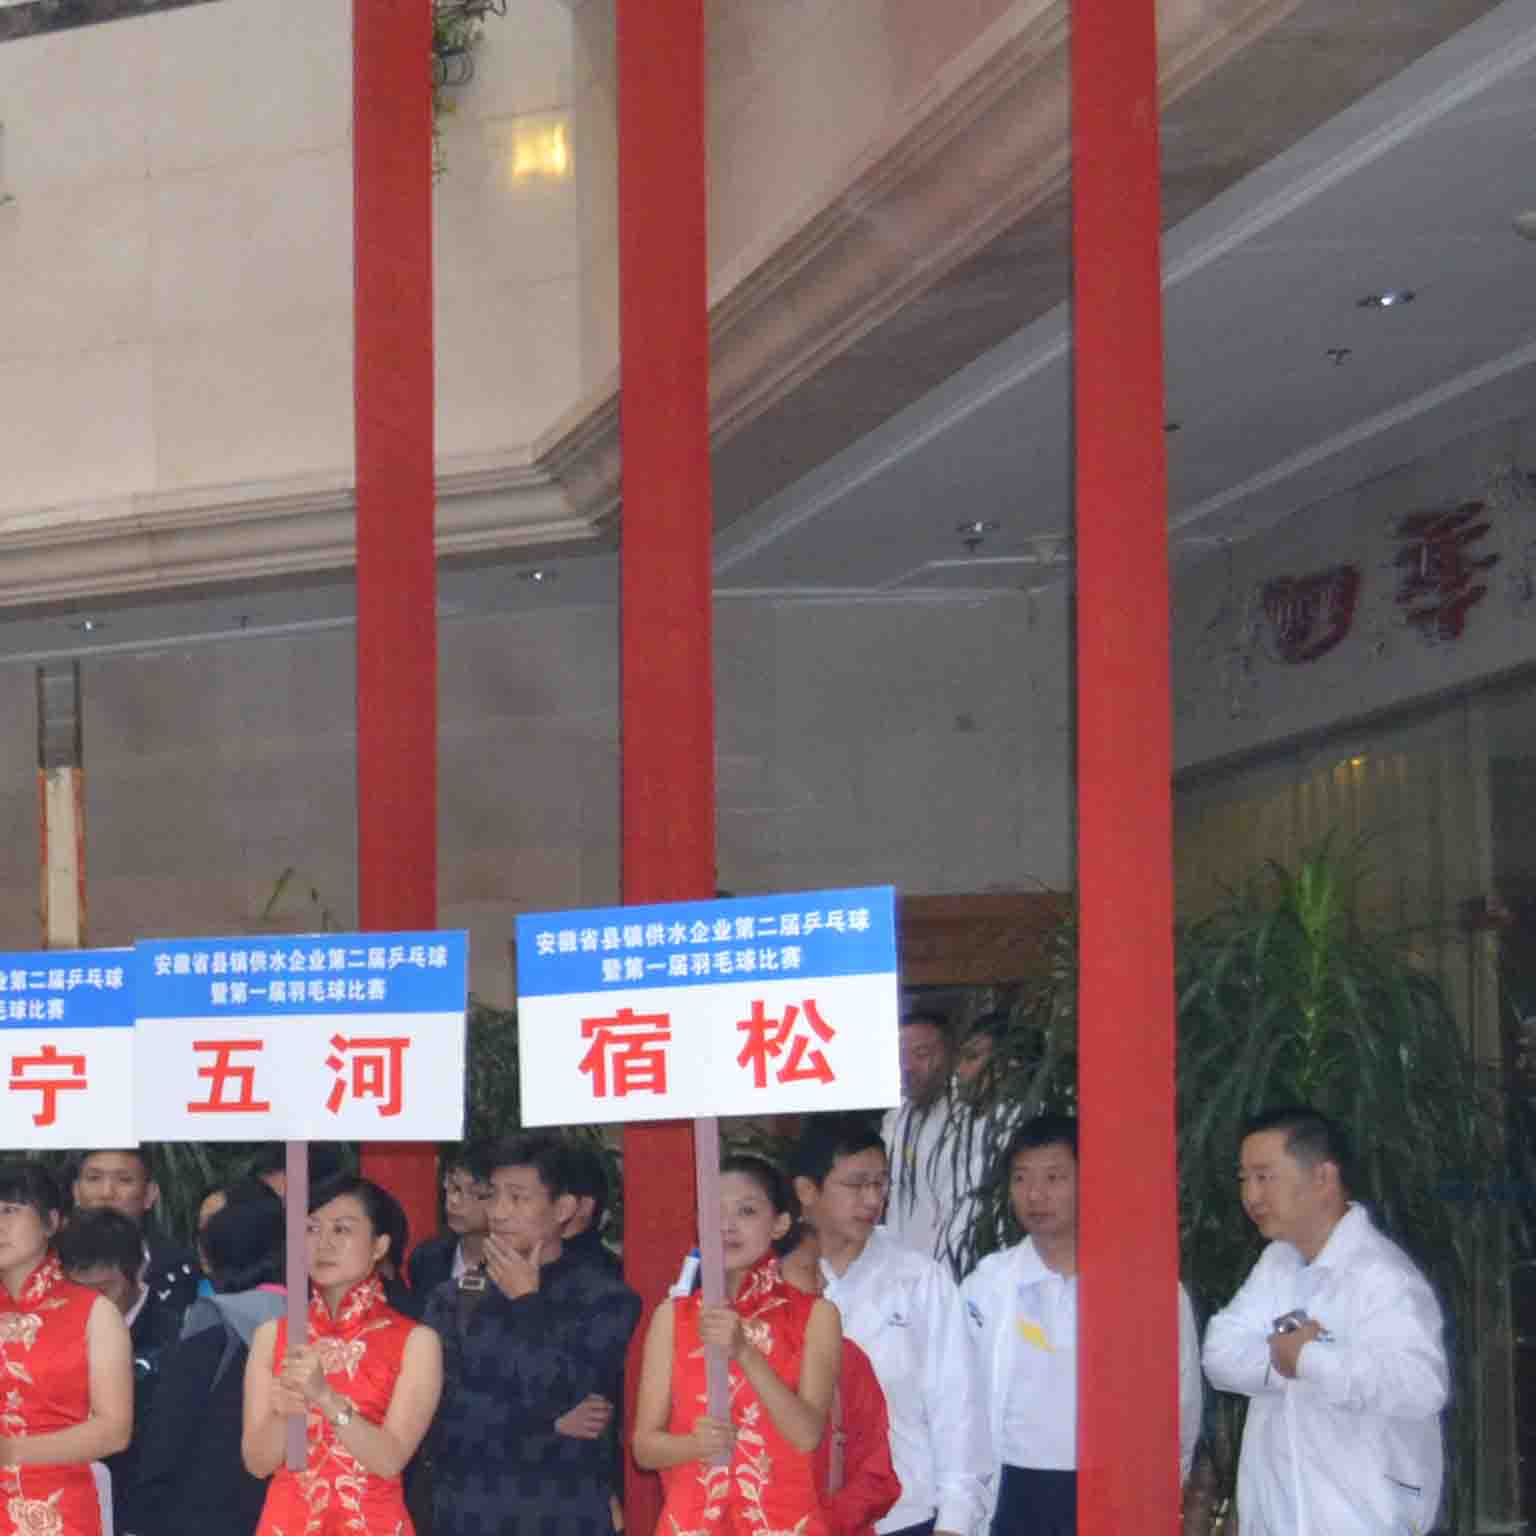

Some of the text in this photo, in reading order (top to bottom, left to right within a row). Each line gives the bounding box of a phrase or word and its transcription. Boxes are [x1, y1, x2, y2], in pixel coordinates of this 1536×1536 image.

[536, 909, 870, 956] 安徽省县镇供水企业第二届乒乓球
[154, 946, 448, 976] 安徽省县镇供水企业第二届乒乓球
[601, 945, 802, 983] 暨第一届羽毛球比赛
[211, 978, 387, 1005] 暨第一届羽毛球比赛
[577, 999, 837, 1099] 宿松
[186, 1032, 411, 1117] 五河
